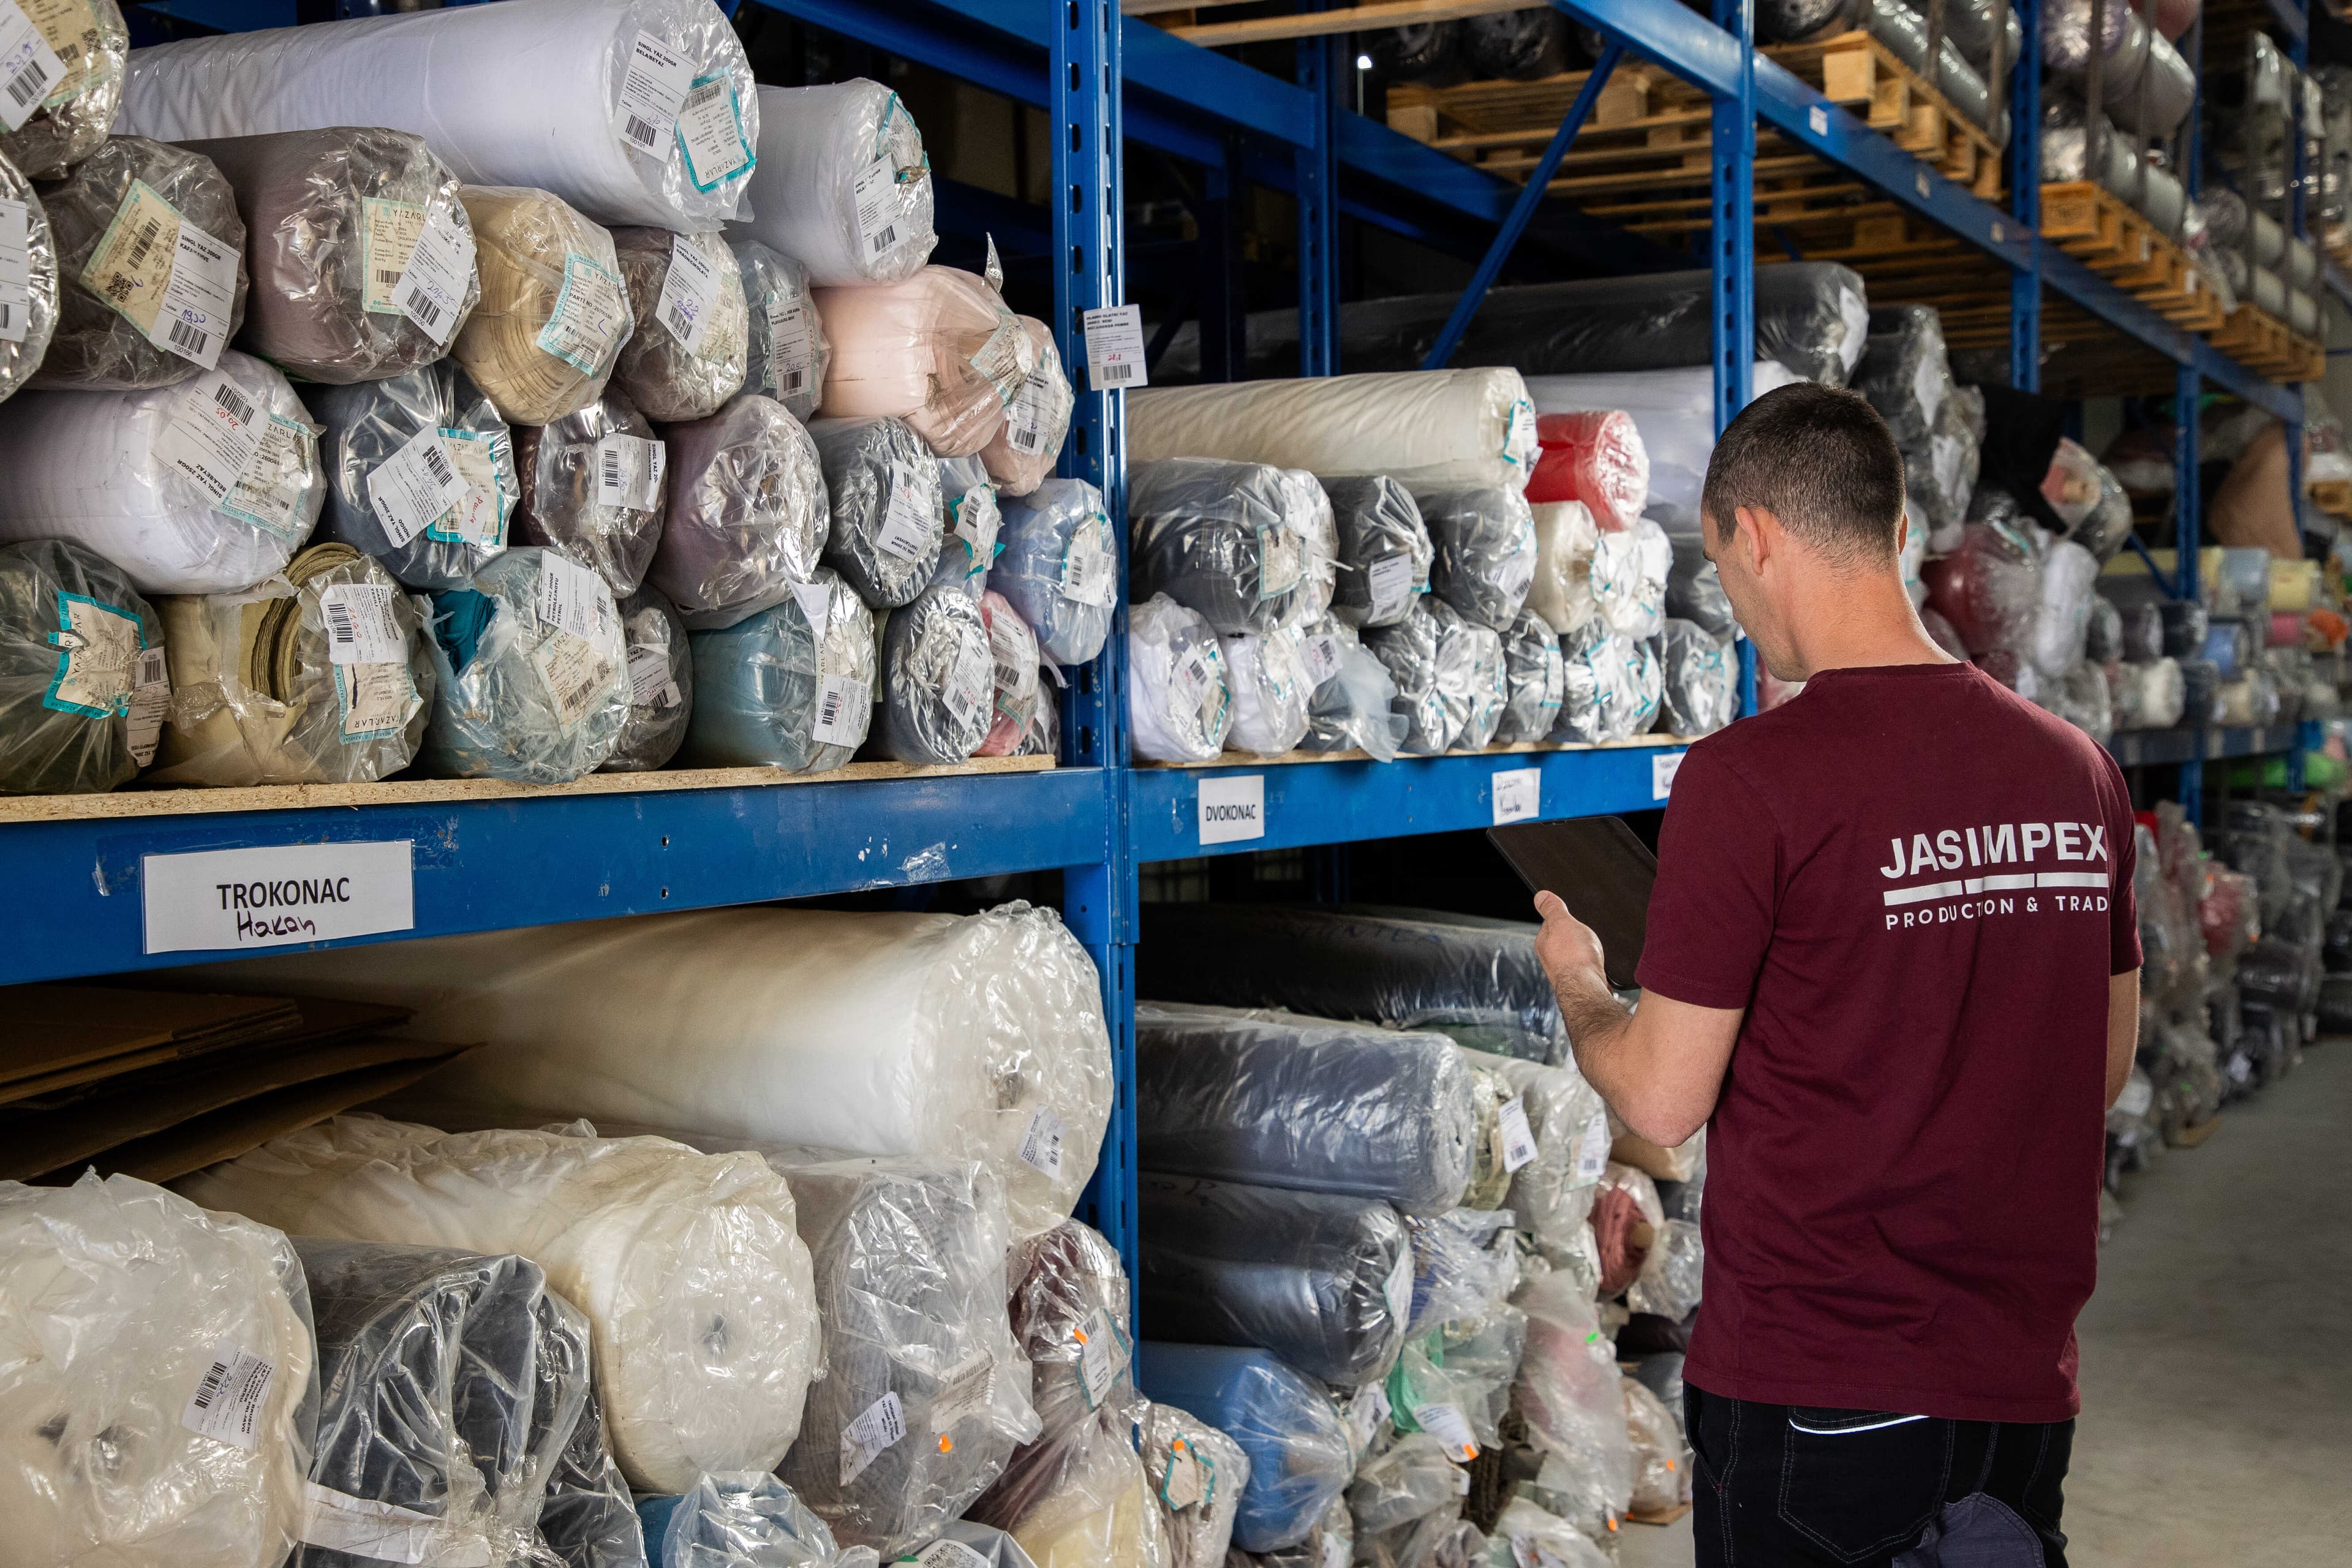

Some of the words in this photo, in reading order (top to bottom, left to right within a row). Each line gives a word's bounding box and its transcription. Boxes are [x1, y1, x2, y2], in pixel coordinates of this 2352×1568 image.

[636, 49, 664, 67] BELA/BEYAZ
[638, 42, 652, 53] SINGL
[654, 50, 662, 58] YAZ
[630, 137, 645, 148] 100101
[706, 157, 736, 178] YAZARLAR
[181, 235, 197, 246] SINGL
[197, 243, 207, 253] YAZ
[410, 311, 424, 326] 100150
[173, 344, 192, 358] 100166
[232, 385, 248, 402] 100201
[177, 459, 195, 475] 250GR
[439, 450, 450, 469] 100114
[196, 464, 227, 492] BELA/BEYAZ
[196, 473, 206, 484] YAZ
[207, 484, 222, 499] SINGL
[378, 496, 390, 514] 200GR
[394, 526, 405, 543] SINGL
[398, 519, 411, 538] INDIGO
[1206, 804, 1256, 821] DVOKONAC
[1880, 822, 2108, 879] JASIMPEX
[216, 877, 350, 910] TROKONAC
[1886, 898, 2014, 930] PRODUCTION
[2027, 897, 2038, 912] &
[237, 911, 315, 941] Hakan
